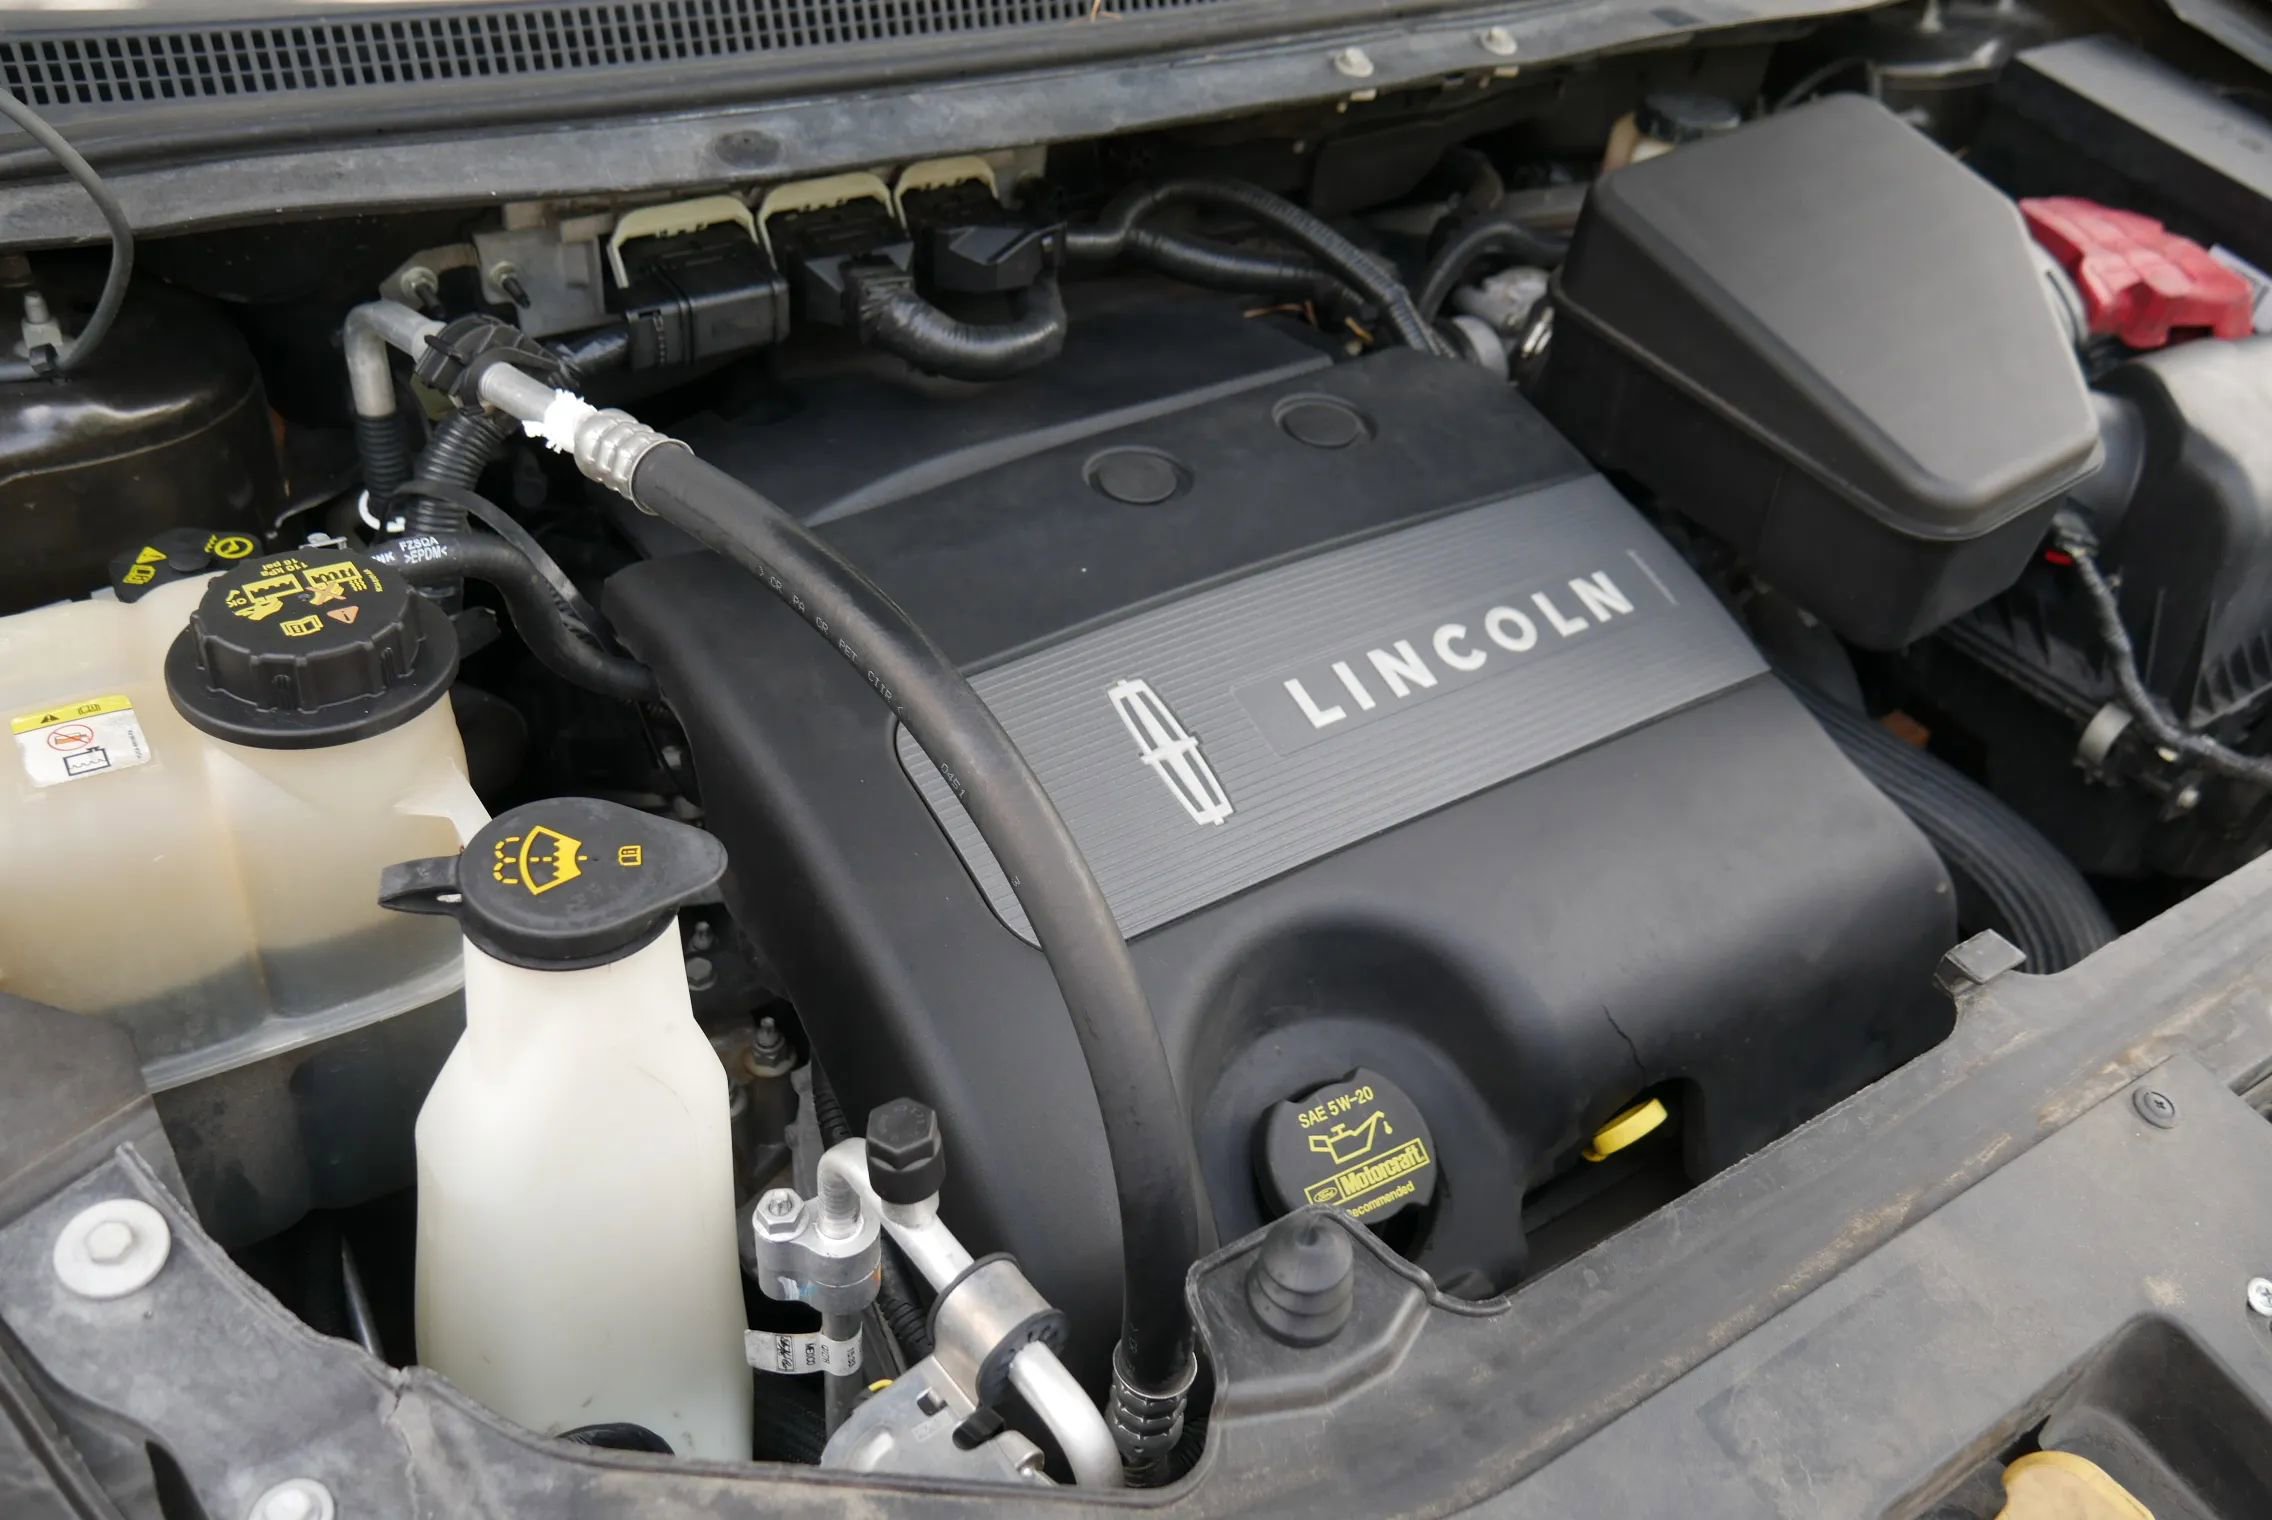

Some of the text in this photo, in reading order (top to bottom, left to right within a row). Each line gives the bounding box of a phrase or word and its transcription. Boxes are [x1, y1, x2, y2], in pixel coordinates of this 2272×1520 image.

[260, 562, 308, 577] 110 kPa
[227, 597, 247, 608] OK
[838, 638, 858, 662] PET
[1283, 570, 1635, 729] LINCOLN
[1298, 1086, 1374, 1128] SAE 5W-20
[1339, 1144, 1425, 1195] Motorcraft
